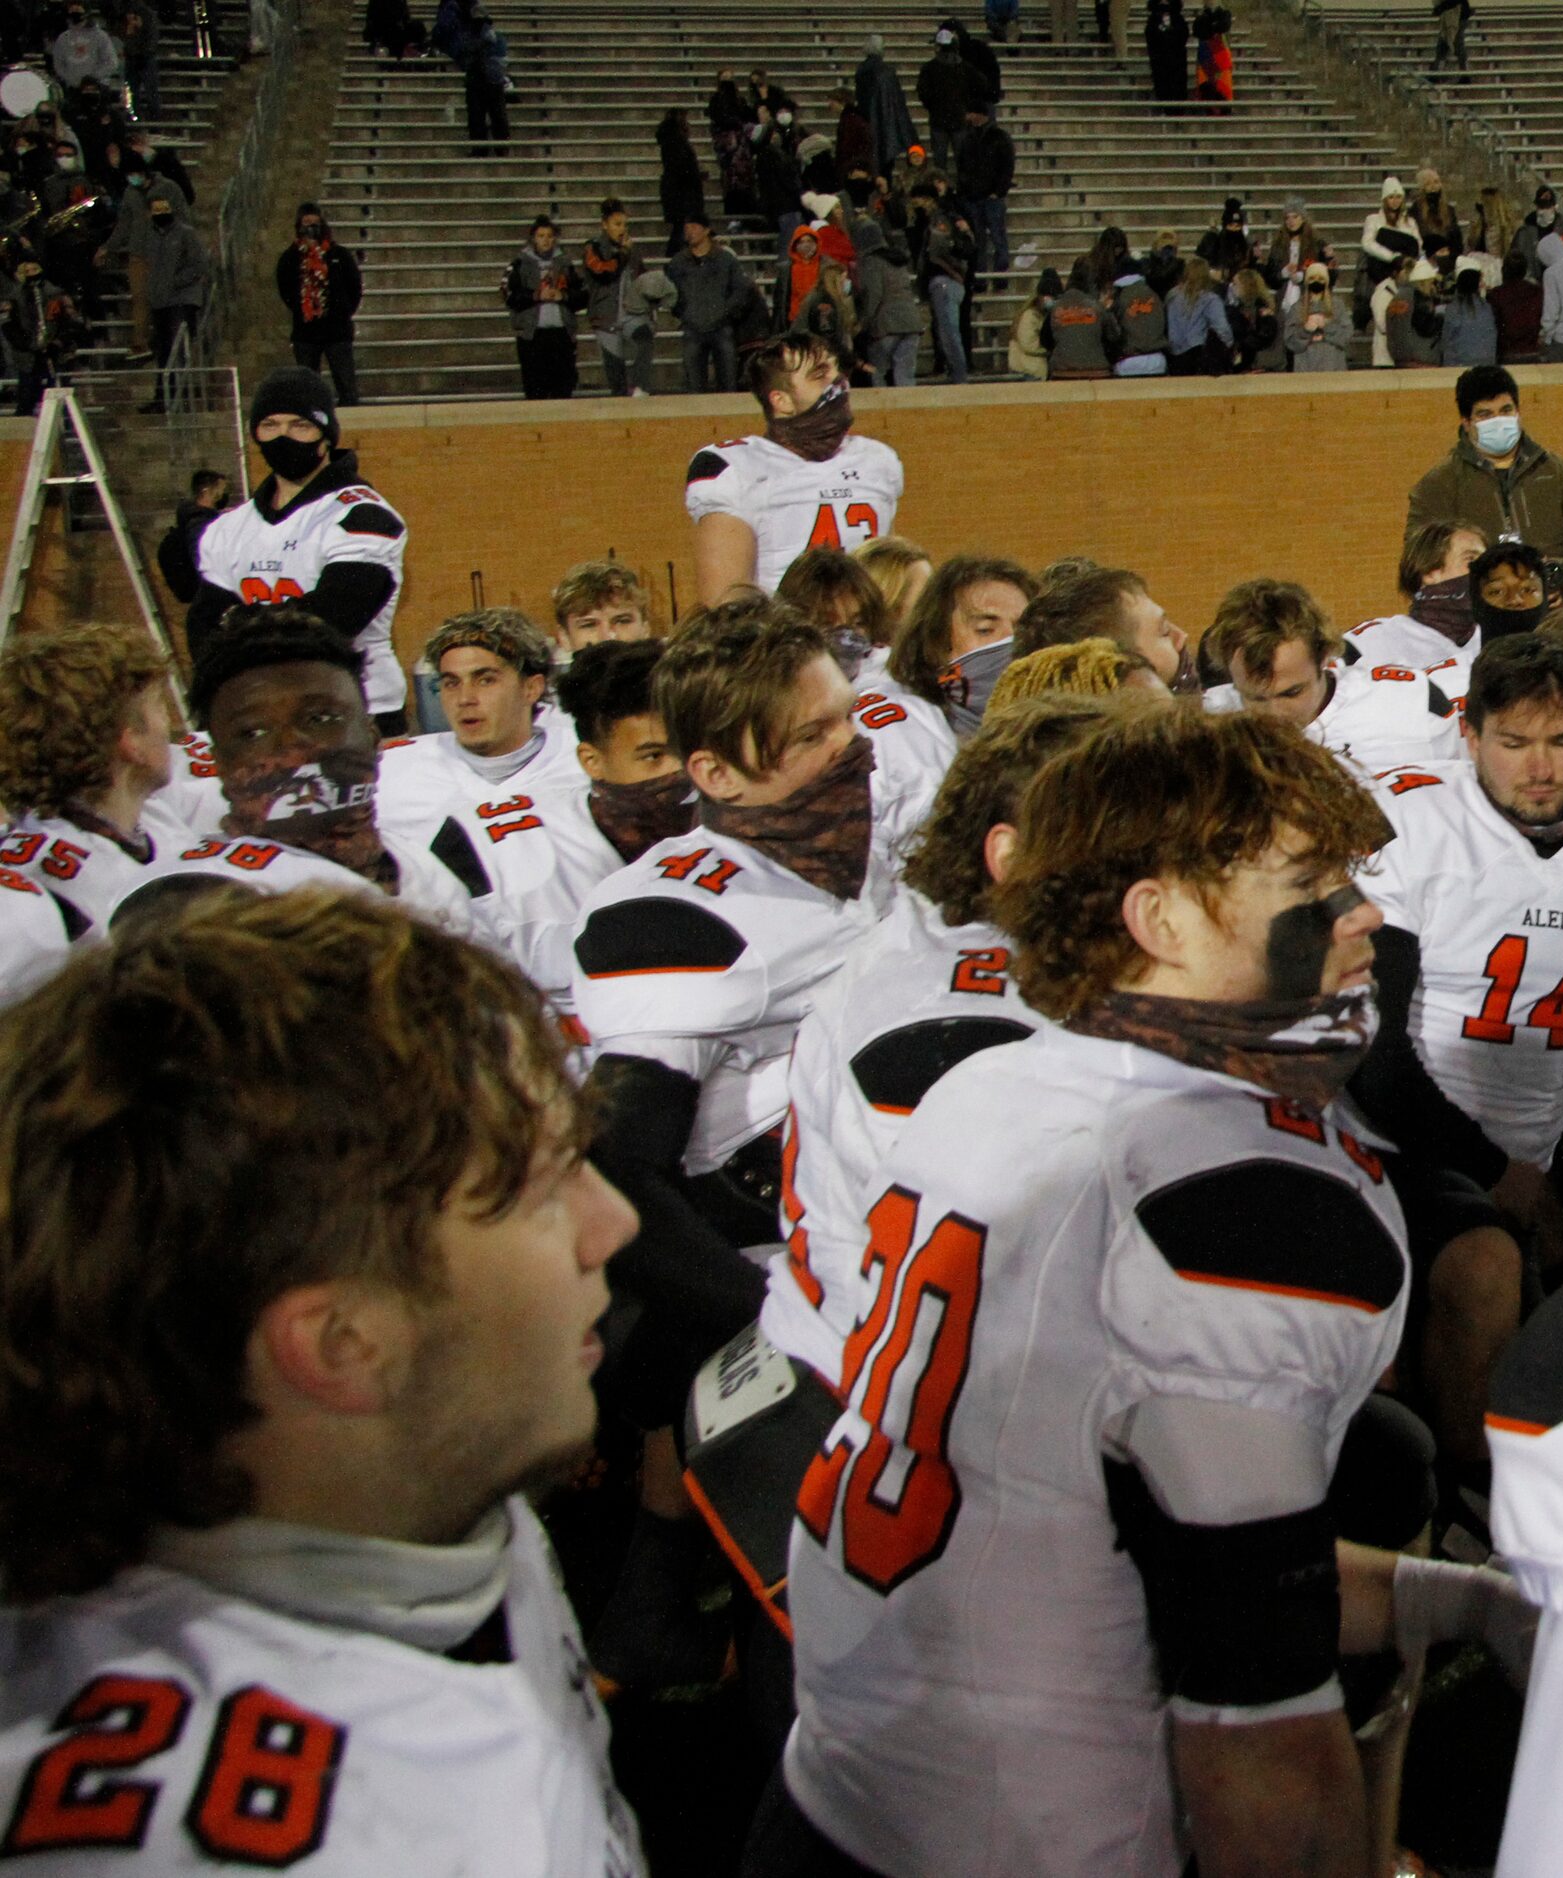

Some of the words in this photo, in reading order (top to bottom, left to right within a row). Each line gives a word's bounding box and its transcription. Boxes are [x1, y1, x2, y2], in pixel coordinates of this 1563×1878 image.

[0, 832, 91, 881] 35
[655, 847, 744, 896] 41
[4, 1673, 348, 1869] 28
